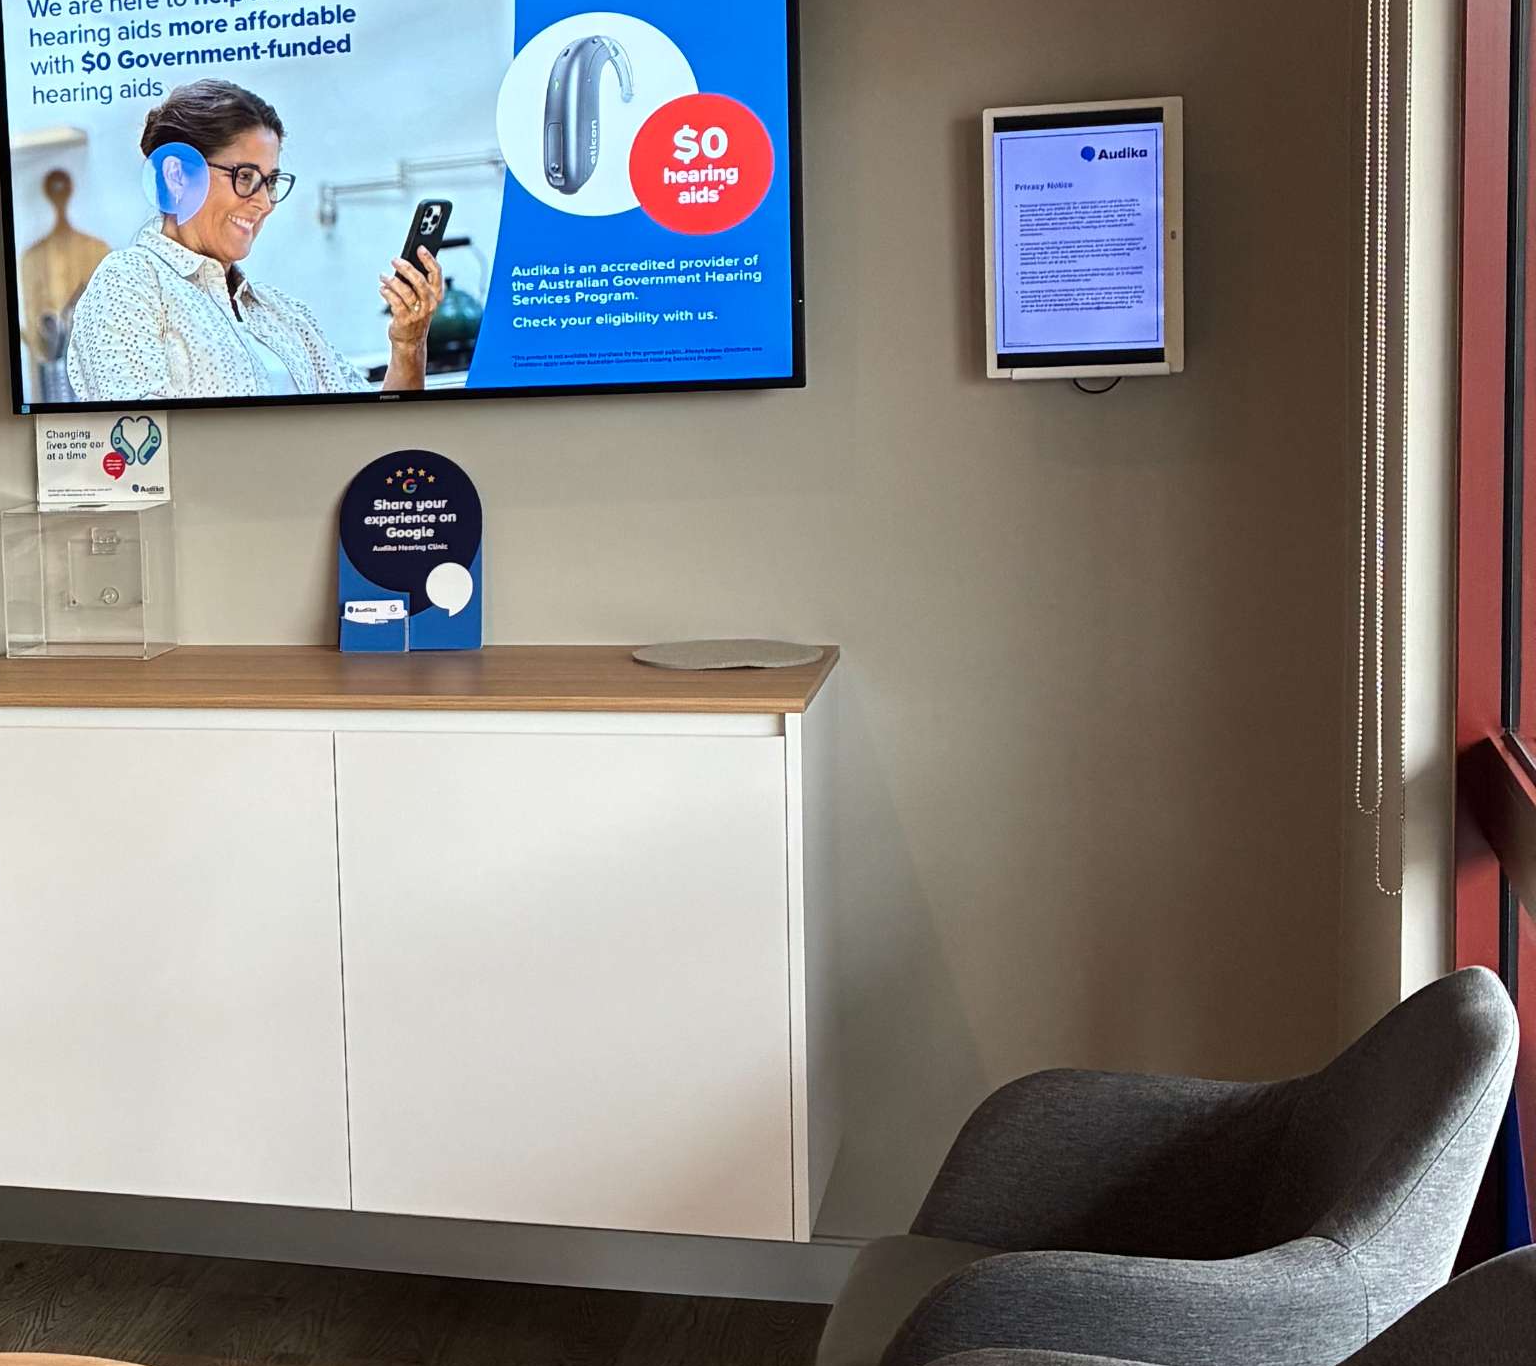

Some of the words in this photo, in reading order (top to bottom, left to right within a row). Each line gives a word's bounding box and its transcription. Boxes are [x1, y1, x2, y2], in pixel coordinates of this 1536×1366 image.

[29, 23, 110, 47] hearing
[117, 19, 162, 41] aids
[169, 18, 228, 36] more
[235, 4, 356, 31] affordable
[30, 54, 74, 76] with
[81, 50, 111, 75] $0
[117, 33, 351, 69] Government-funded
[33, 82, 113, 105] hearing
[119, 77, 163, 98] aids
[673, 124, 728, 165] $0
[1098, 147, 1148, 160] Audika
[663, 164, 739, 185] hearing
[512, 264, 560, 277] Audika
[564, 263, 575, 274] is
[579, 265, 596, 274] an
[601, 258, 675, 272] accredited
[679, 256, 740, 271] provider
[744, 254, 759, 266] of
[512, 281, 534, 292] the
[538, 277, 609, 290] Australian
[612, 273, 701, 287] Government
[705, 269, 762, 283] Hearing
[512, 293, 571, 306] Services
[575, 291, 639, 304] Program.
[512, 316, 557, 328] Check
[560, 316, 592, 329] your
[595, 311, 659, 326] eligibility
[663, 310, 694, 322] with
[698, 311, 718, 321] us.
[46, 430, 91, 440] Changing
[46, 441, 67, 450] lives
[89, 441, 105, 449] ear
[46, 452, 56, 461] at
[66, 451, 87, 460] time
[373, 498, 413, 511] Share
[415, 499, 448, 512] your
[364, 512, 437, 527] experience
[439, 513, 457, 523] on
[386, 525, 435, 540] Google
